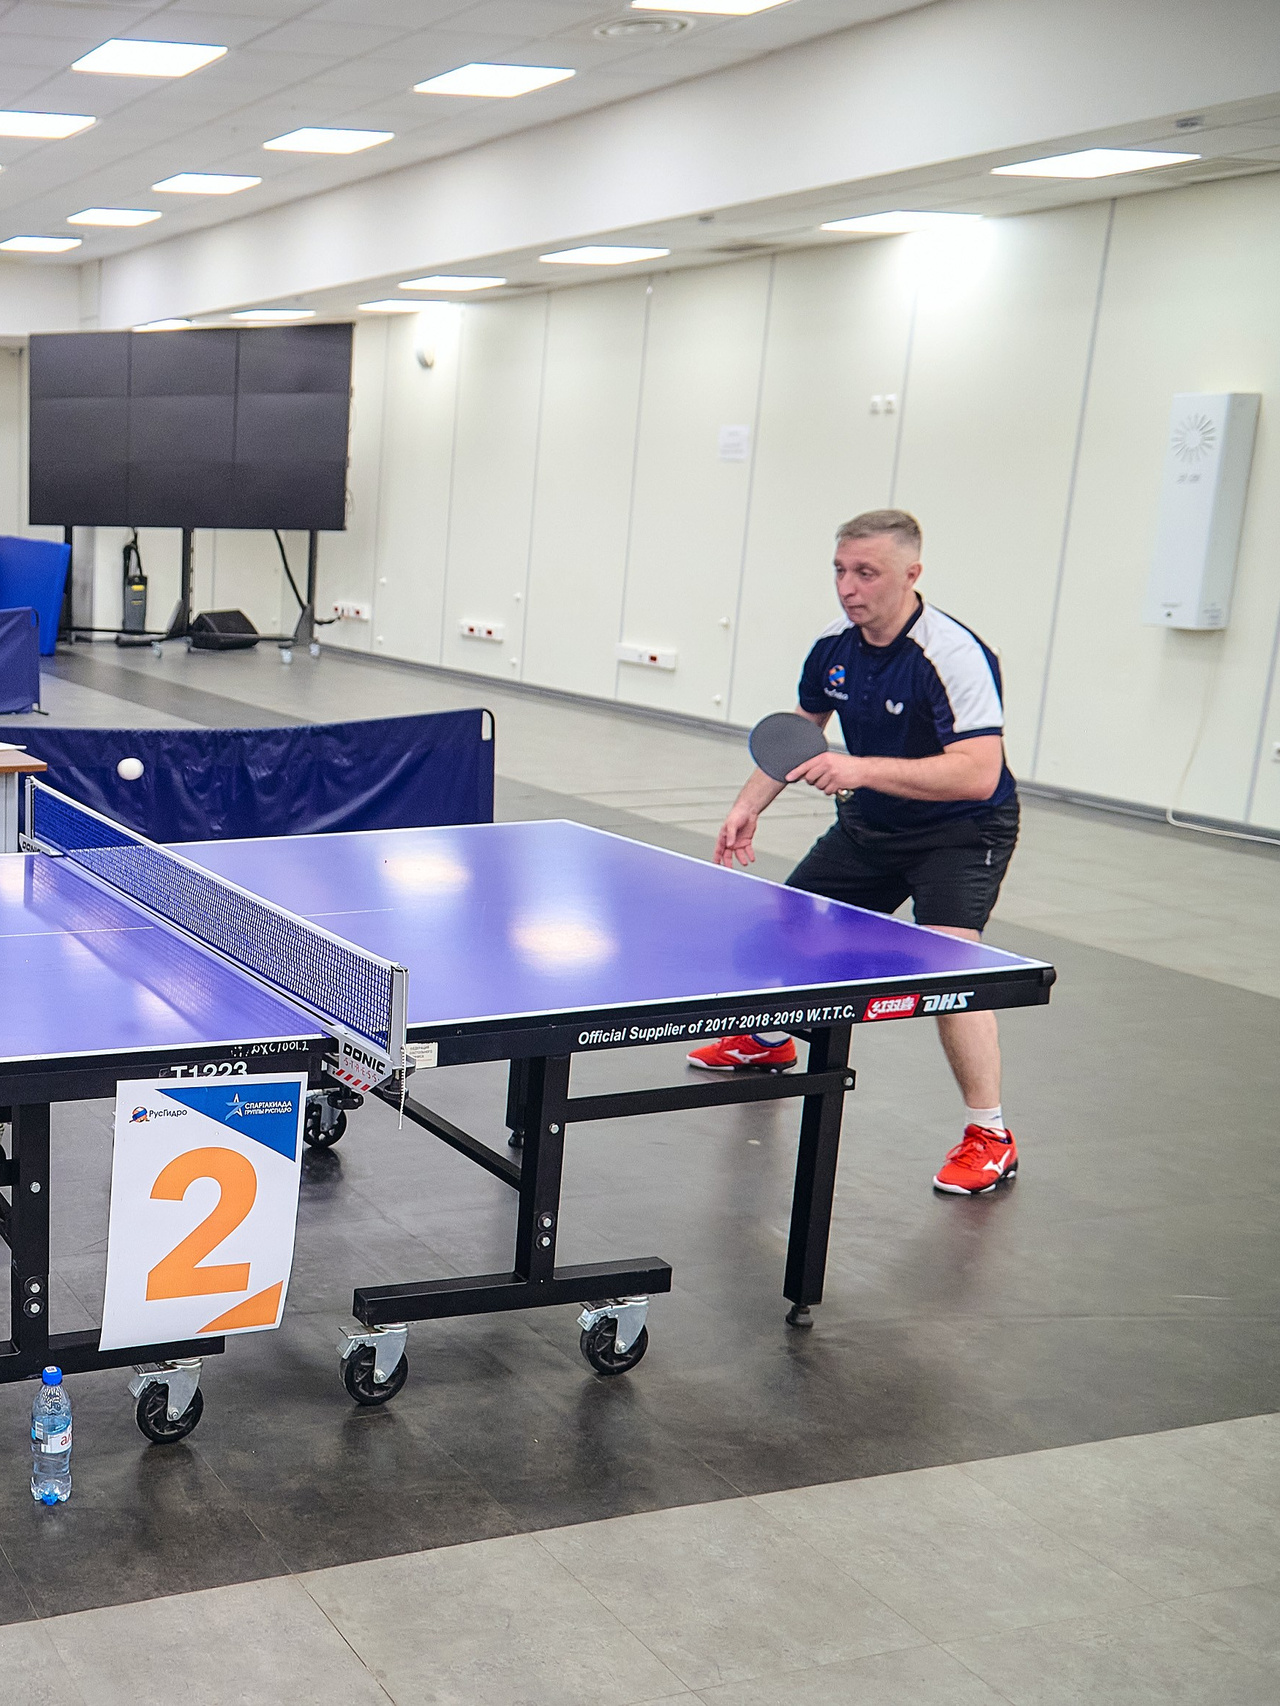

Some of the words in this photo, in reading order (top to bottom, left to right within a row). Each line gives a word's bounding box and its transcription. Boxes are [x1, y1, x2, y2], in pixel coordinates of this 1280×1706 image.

[922, 991, 975, 1013] DHS
[578, 1027, 626, 1046] Official
[629, 1022, 686, 1042] Supplier
[688, 1019, 705, 1034] of
[806, 1004, 856, 1023] W.T.T.C.
[170, 1060, 248, 1079] T1223
[342, 1042, 386, 1076] DONIC
[148, 1109, 188, 1119] РусГидро
[244, 1100, 293, 1110] СПАРТАКИАДА
[145, 1146, 258, 1302] 2
